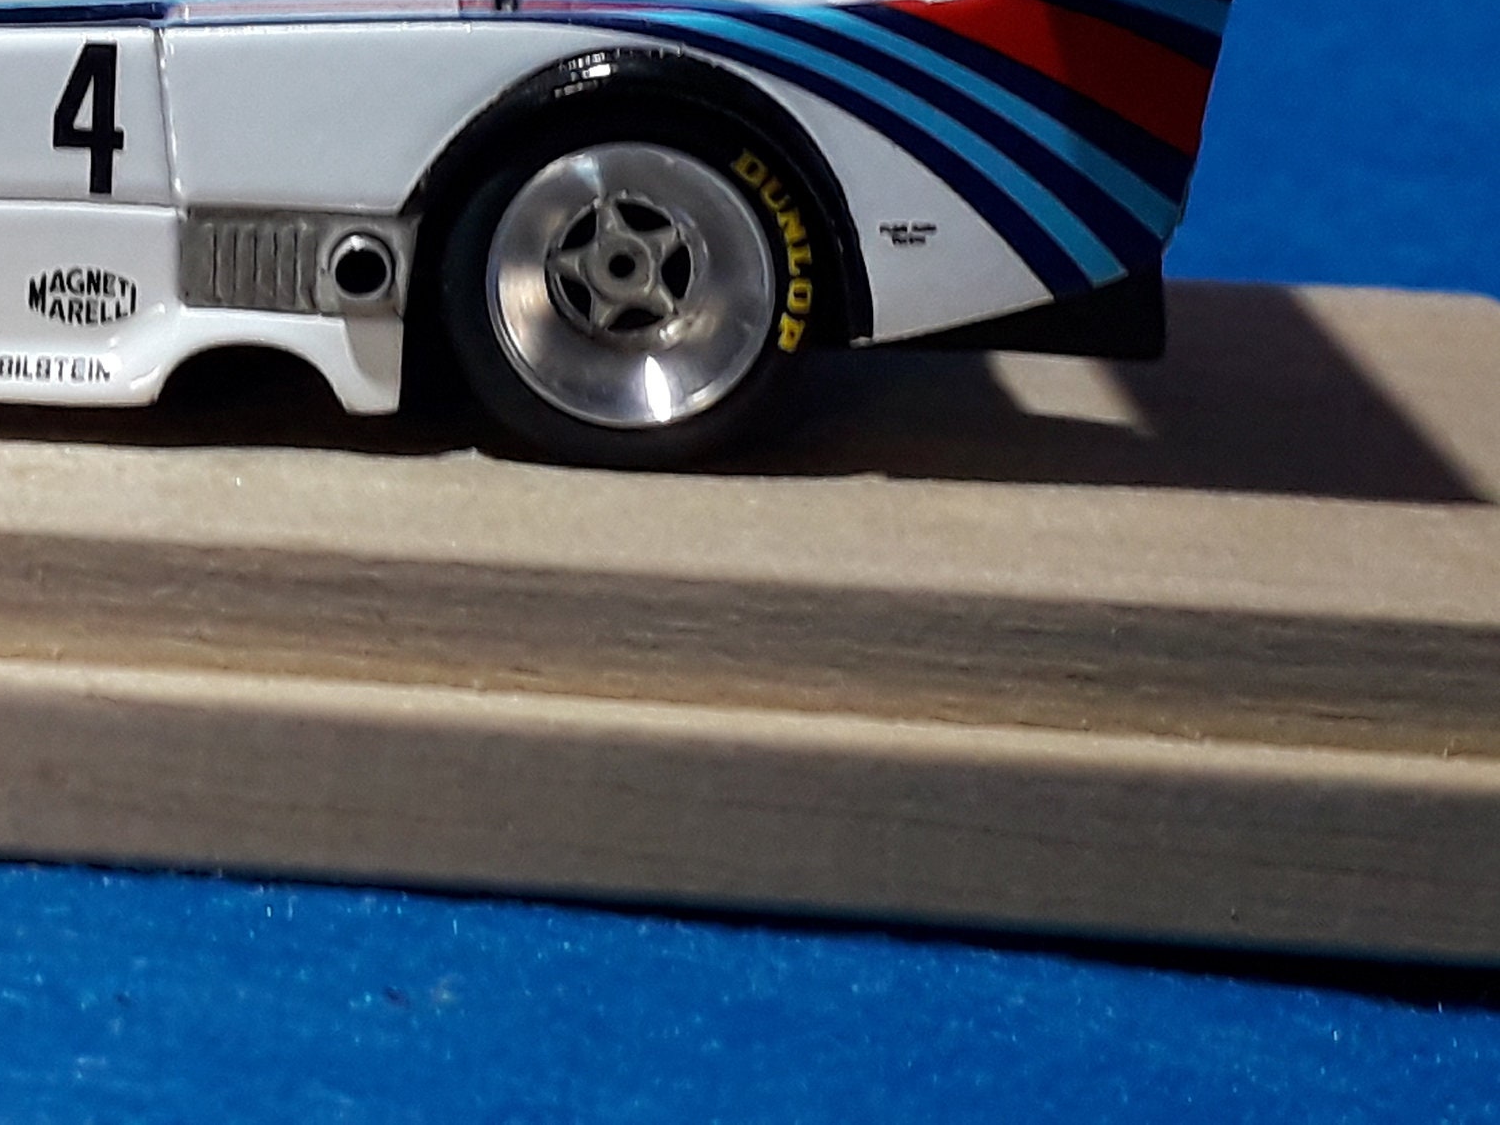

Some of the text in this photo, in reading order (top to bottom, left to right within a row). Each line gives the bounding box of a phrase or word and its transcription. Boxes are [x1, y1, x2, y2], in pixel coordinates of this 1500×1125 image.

[52, 41, 125, 195] 4
[28, 266, 137, 307] MAGNETI
[731, 150, 812, 353] DUNLOP
[28, 287, 137, 325] MARELLI
